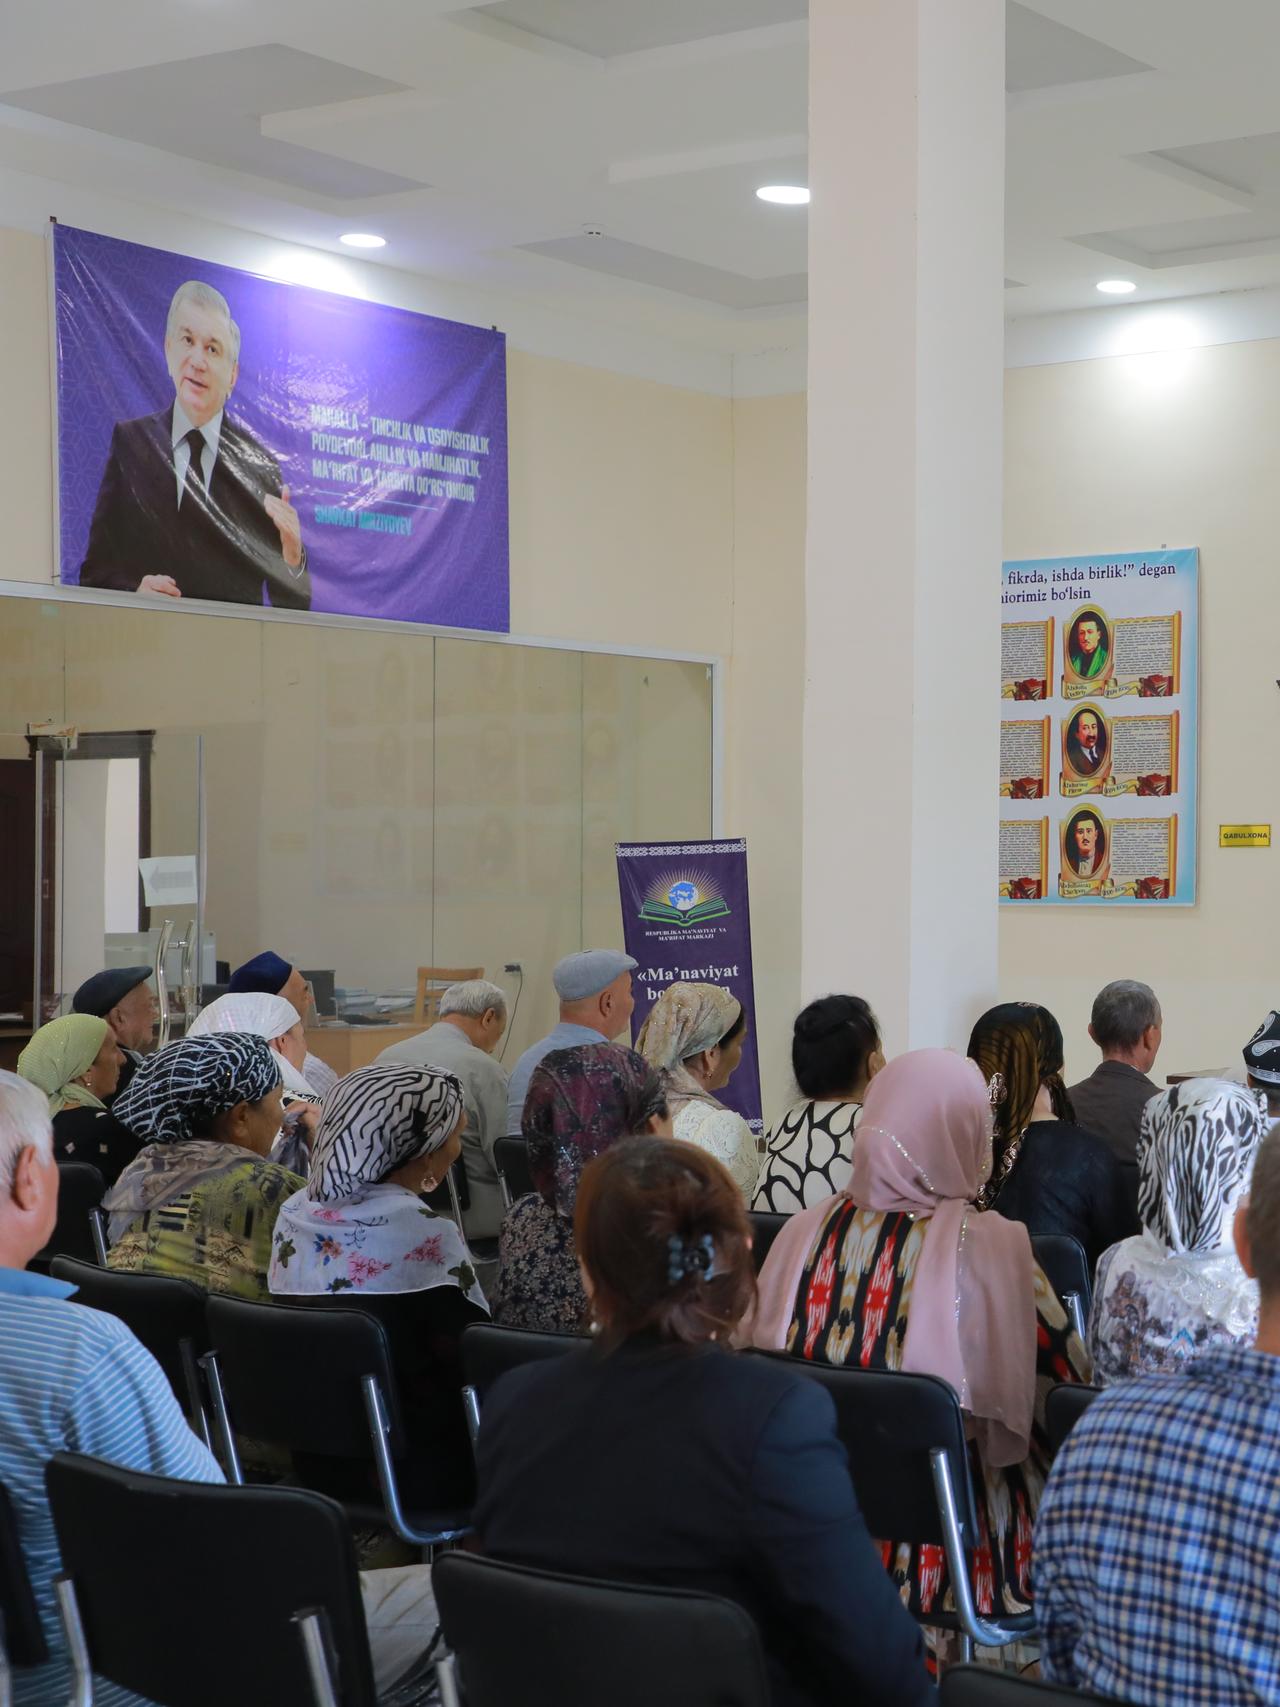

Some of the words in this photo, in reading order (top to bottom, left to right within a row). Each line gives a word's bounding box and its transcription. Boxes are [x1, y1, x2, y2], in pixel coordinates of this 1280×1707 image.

[370, 416, 412, 441] TINCHLIK
[413, 424, 426, 443] VA
[427, 427, 489, 455] OSOYISHTALIK
[370, 442, 405, 466] AHILLIK
[406, 449, 420, 468] VA
[1008, 570, 1048, 585] fikrda,
[1052, 567, 1084, 582] ishda
[1138, 563, 1176, 579] degan
